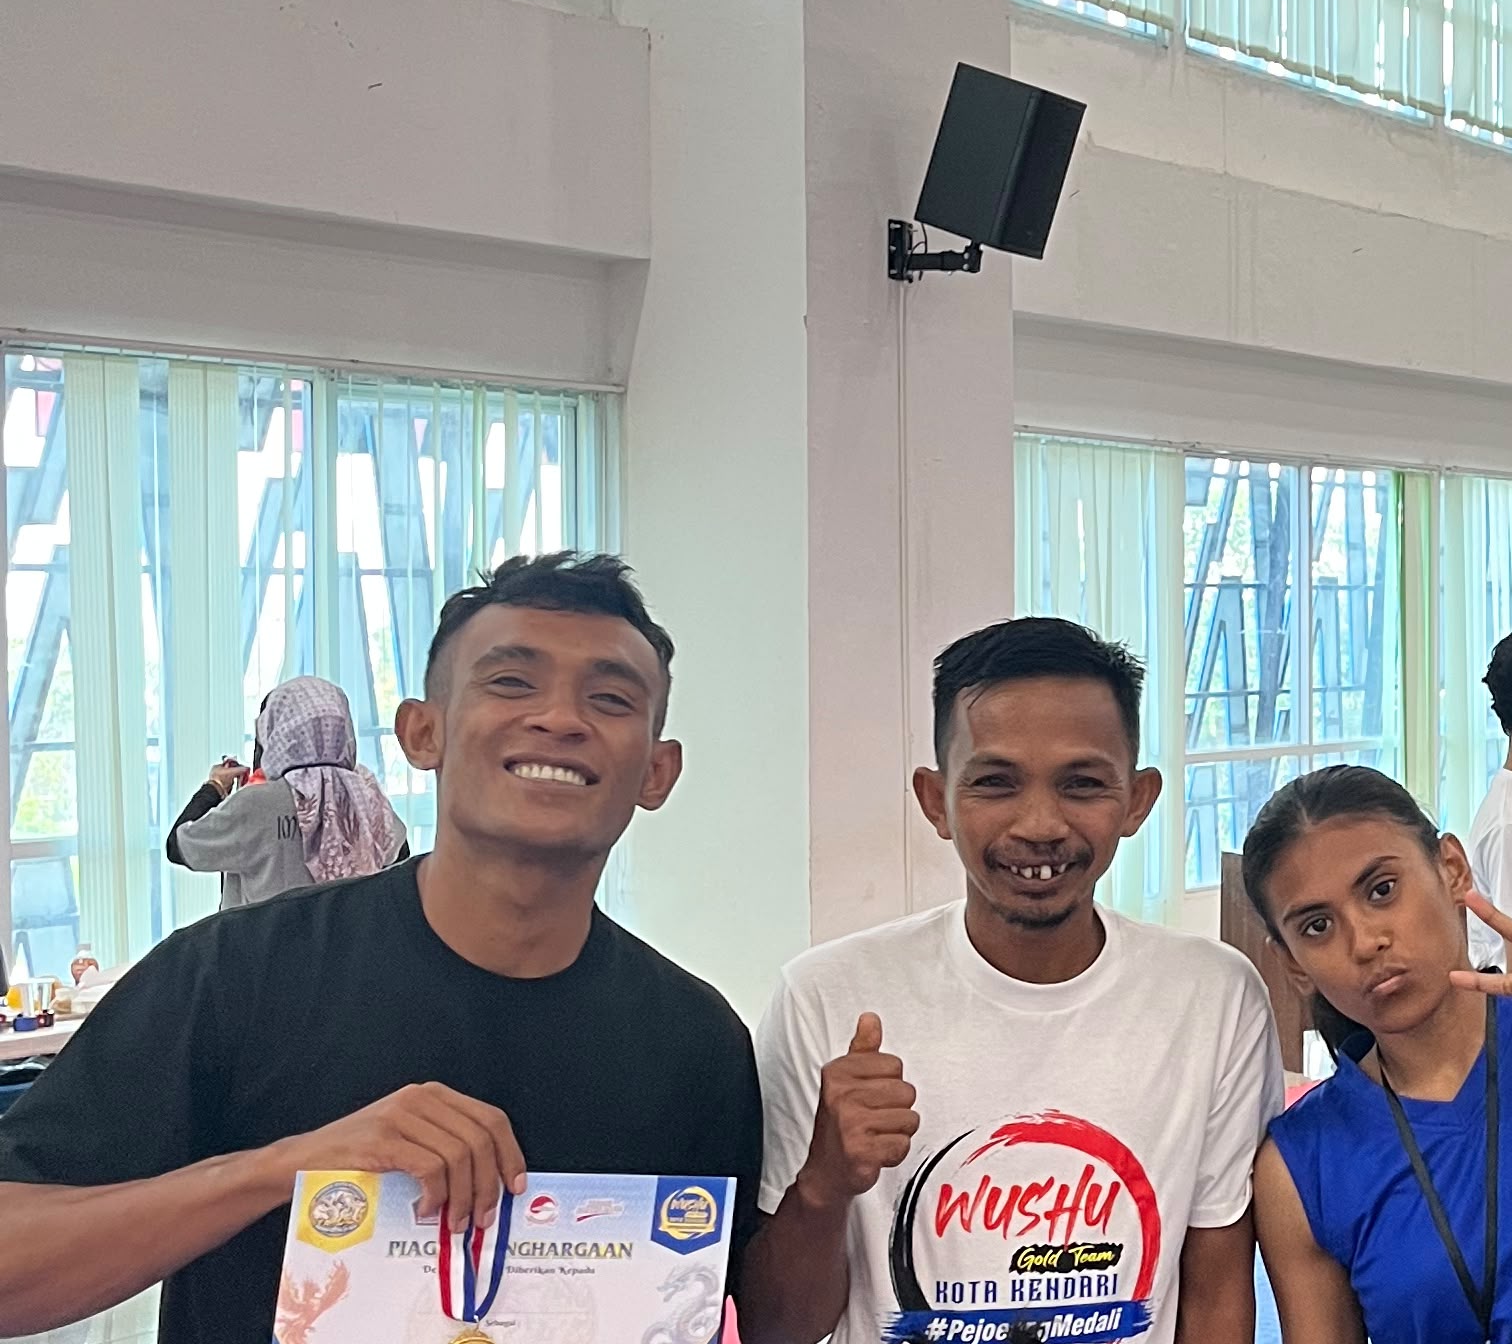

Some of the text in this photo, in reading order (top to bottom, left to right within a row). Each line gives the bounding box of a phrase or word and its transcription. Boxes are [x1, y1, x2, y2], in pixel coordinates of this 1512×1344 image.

[936, 1164, 1120, 1250] WUSHU
[388, 1240, 633, 1259] PIAG NGHARGAAN
[1018, 1247, 1114, 1271] Gold Team
[506, 1265, 555, 1275] Diberikan
[936, 1274, 1117, 1304] KOTA KENDARI
